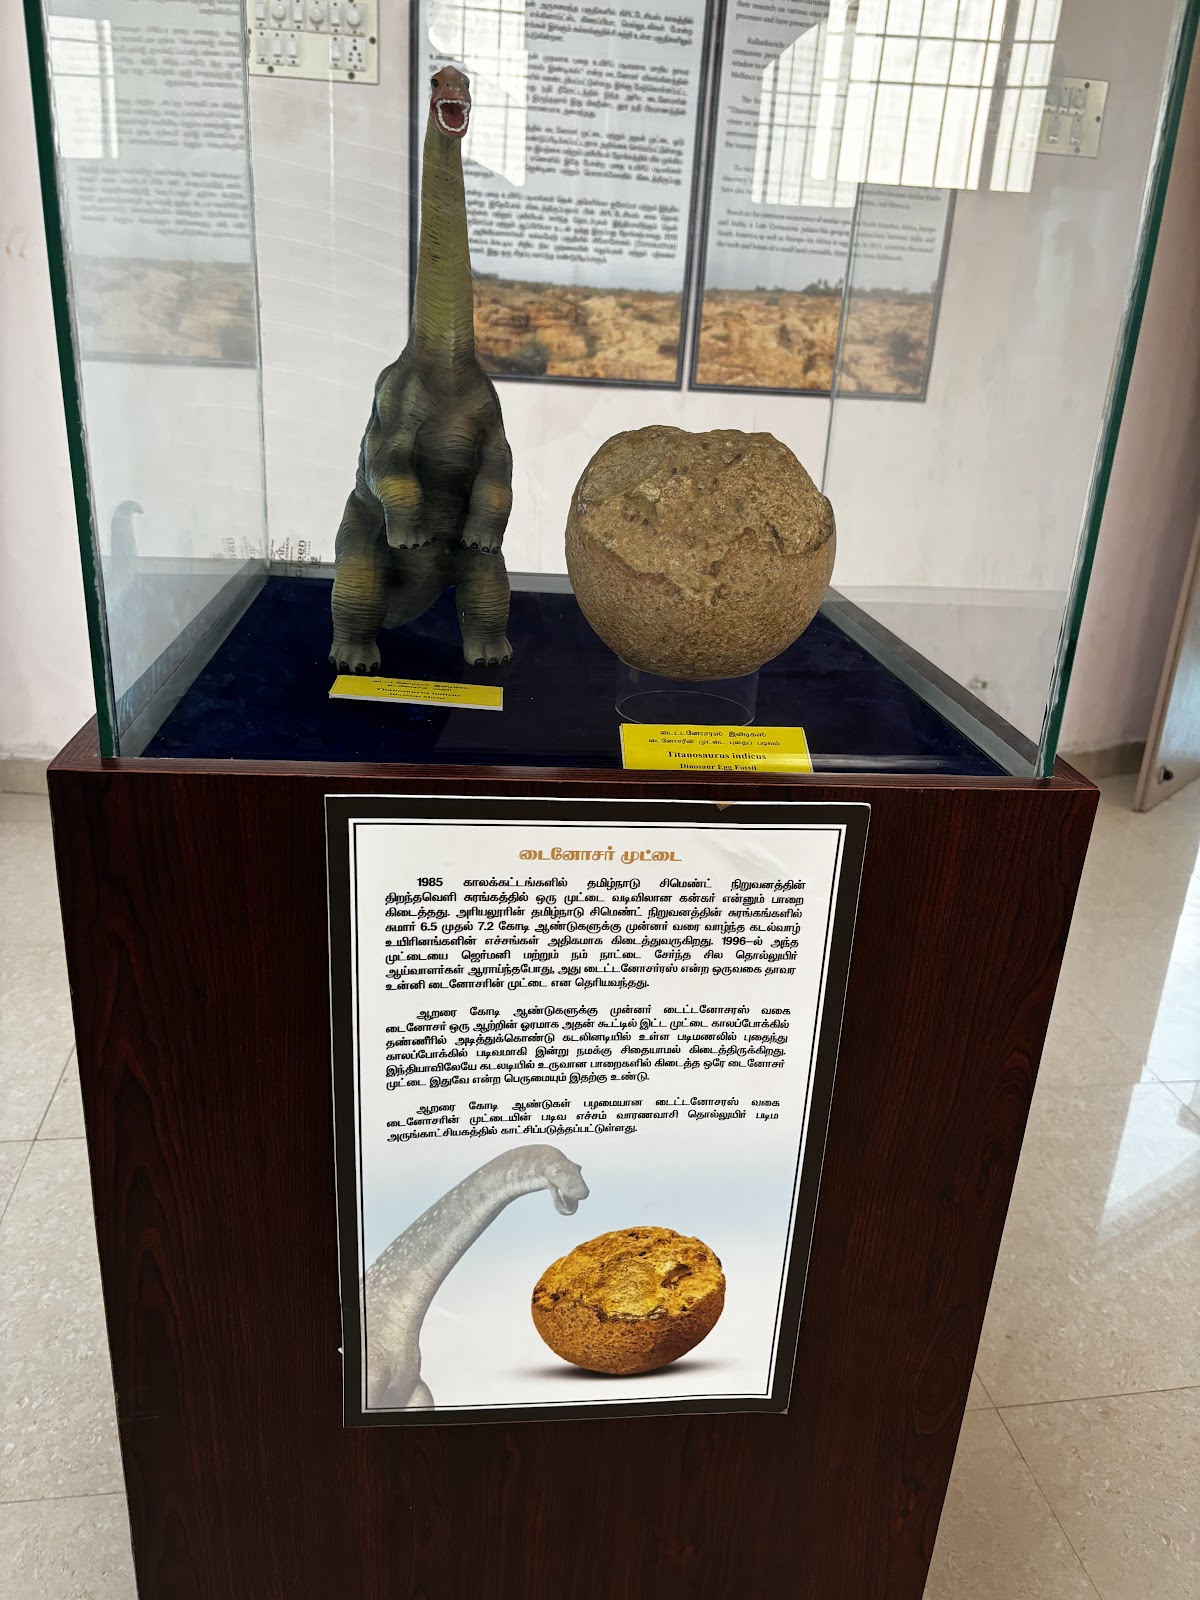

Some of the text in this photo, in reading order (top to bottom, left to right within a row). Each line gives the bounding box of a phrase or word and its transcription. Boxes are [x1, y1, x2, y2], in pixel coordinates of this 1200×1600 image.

[295, 539, 306, 577] Green
[667, 751, 767, 760] Titanosaurus indicus
[519, 845, 682, 864] டைனோசர் முட்டை
[417, 876, 806, 893] 1985 காலக்கட்டங்களில் தமிழ்நாடு சிமெண்ட் நிறுவனத்தின்
[385, 891, 457, 906] திறந்தவெளி
[463, 891, 529, 905] சுரங்கத்தில்
[535, 895, 557, 905] ஒரு
[564, 891, 604, 905] முட்டை
[612, 892, 673, 905] வடிவிலான
[722, 893, 765, 906] என்னும்
[771, 897, 804, 907] பாறை
[385, 906, 802, 920] கிடைத்தது. அரியலூரின் தமிழ்நாடு சிமெண்ட் நிறுவனத்தின் சுரங்கங்களில்
[385, 920, 801, 936] சுமார் 6.5 முதல் 7.2 கோடி ஆண்டுகளுக்கு முன்னர் வரை வாழ்ந்த கடல்வாழ்
[385, 935, 477, 947] உயிரினங்களின்
[485, 935, 539, 945] எச்சங்கள்
[547, 935, 603, 948] அதிகமாக
[770, 936, 799, 949] அந்த
[385, 949, 798, 965] முட்டையை ஜெர்மனி மற்றும் நம் நாட்டை சேர்ந்த சில தொல்லுயிர்
[385, 964, 464, 980] ஆய்வாளர்கள்
[557, 966, 581, 976] அது
[680, 963, 709, 976] என்ற
[712, 966, 762, 976] ஒருவகை
[764, 967, 796, 976] தாவர
[385, 979, 425, 991] உன்னி
[428, 978, 505, 989] டைனோசரின்
[507, 977, 547, 991] முட்டை
[575, 977, 650, 990] தெரியவந்தது.
[416, 1009, 458, 1021] ஆறரை
[469, 1006, 500, 1018] கோடி
[513, 1004, 598, 1019] ஆண்டுகளுக்கு
[610, 1004, 651, 1017] முன்னர்
[663, 1004, 750, 1015] டைட்டனோசரஸ்
[385, 1018, 790, 1033] டைனோசர் ஒரு ஆற்றின் ஓரமாக அதன் கூட்டில் இட்ட முட்டை காலப்போக்கில்
[454, 1032, 555, 1047] அடித்துக்கொண்டு
[562, 1031, 632, 1044] கடலினடியில்
[638, 1031, 670, 1041] உள்ள
[677, 1031, 737, 1043] படிமணலில்
[744, 1032, 788, 1044] புதைந்து
[386, 1044, 786, 1061] காலப்போக்கில் படிவமாகி இன்று நமக்கு சிதையாமல் கிடைத்திருக்கிறது.
[385, 1057, 786, 1078] இந்தியாவிலேயே கடலடியில் உருவான பாறைகளில் கிடைத்த ஒரே டைனோசர்
[386, 1071, 650, 1091] முட்டை இதுவே என்ற பெருமையும் இதற்கு உண்டு.
[416, 1104, 456, 1116] ஆறரை
[468, 1101, 498, 1112] கோடி
[511, 1098, 571, 1112] ஆண்டுகள்
[583, 1100, 643, 1110] பழமையான
[655, 1096, 739, 1107] டைட்டனோசரஸ்
[386, 1109, 779, 1128] டைனோசரின் முட்டையின் படிவ எச்சம் வாரணவாசி தொல்லுயிர் படிம
